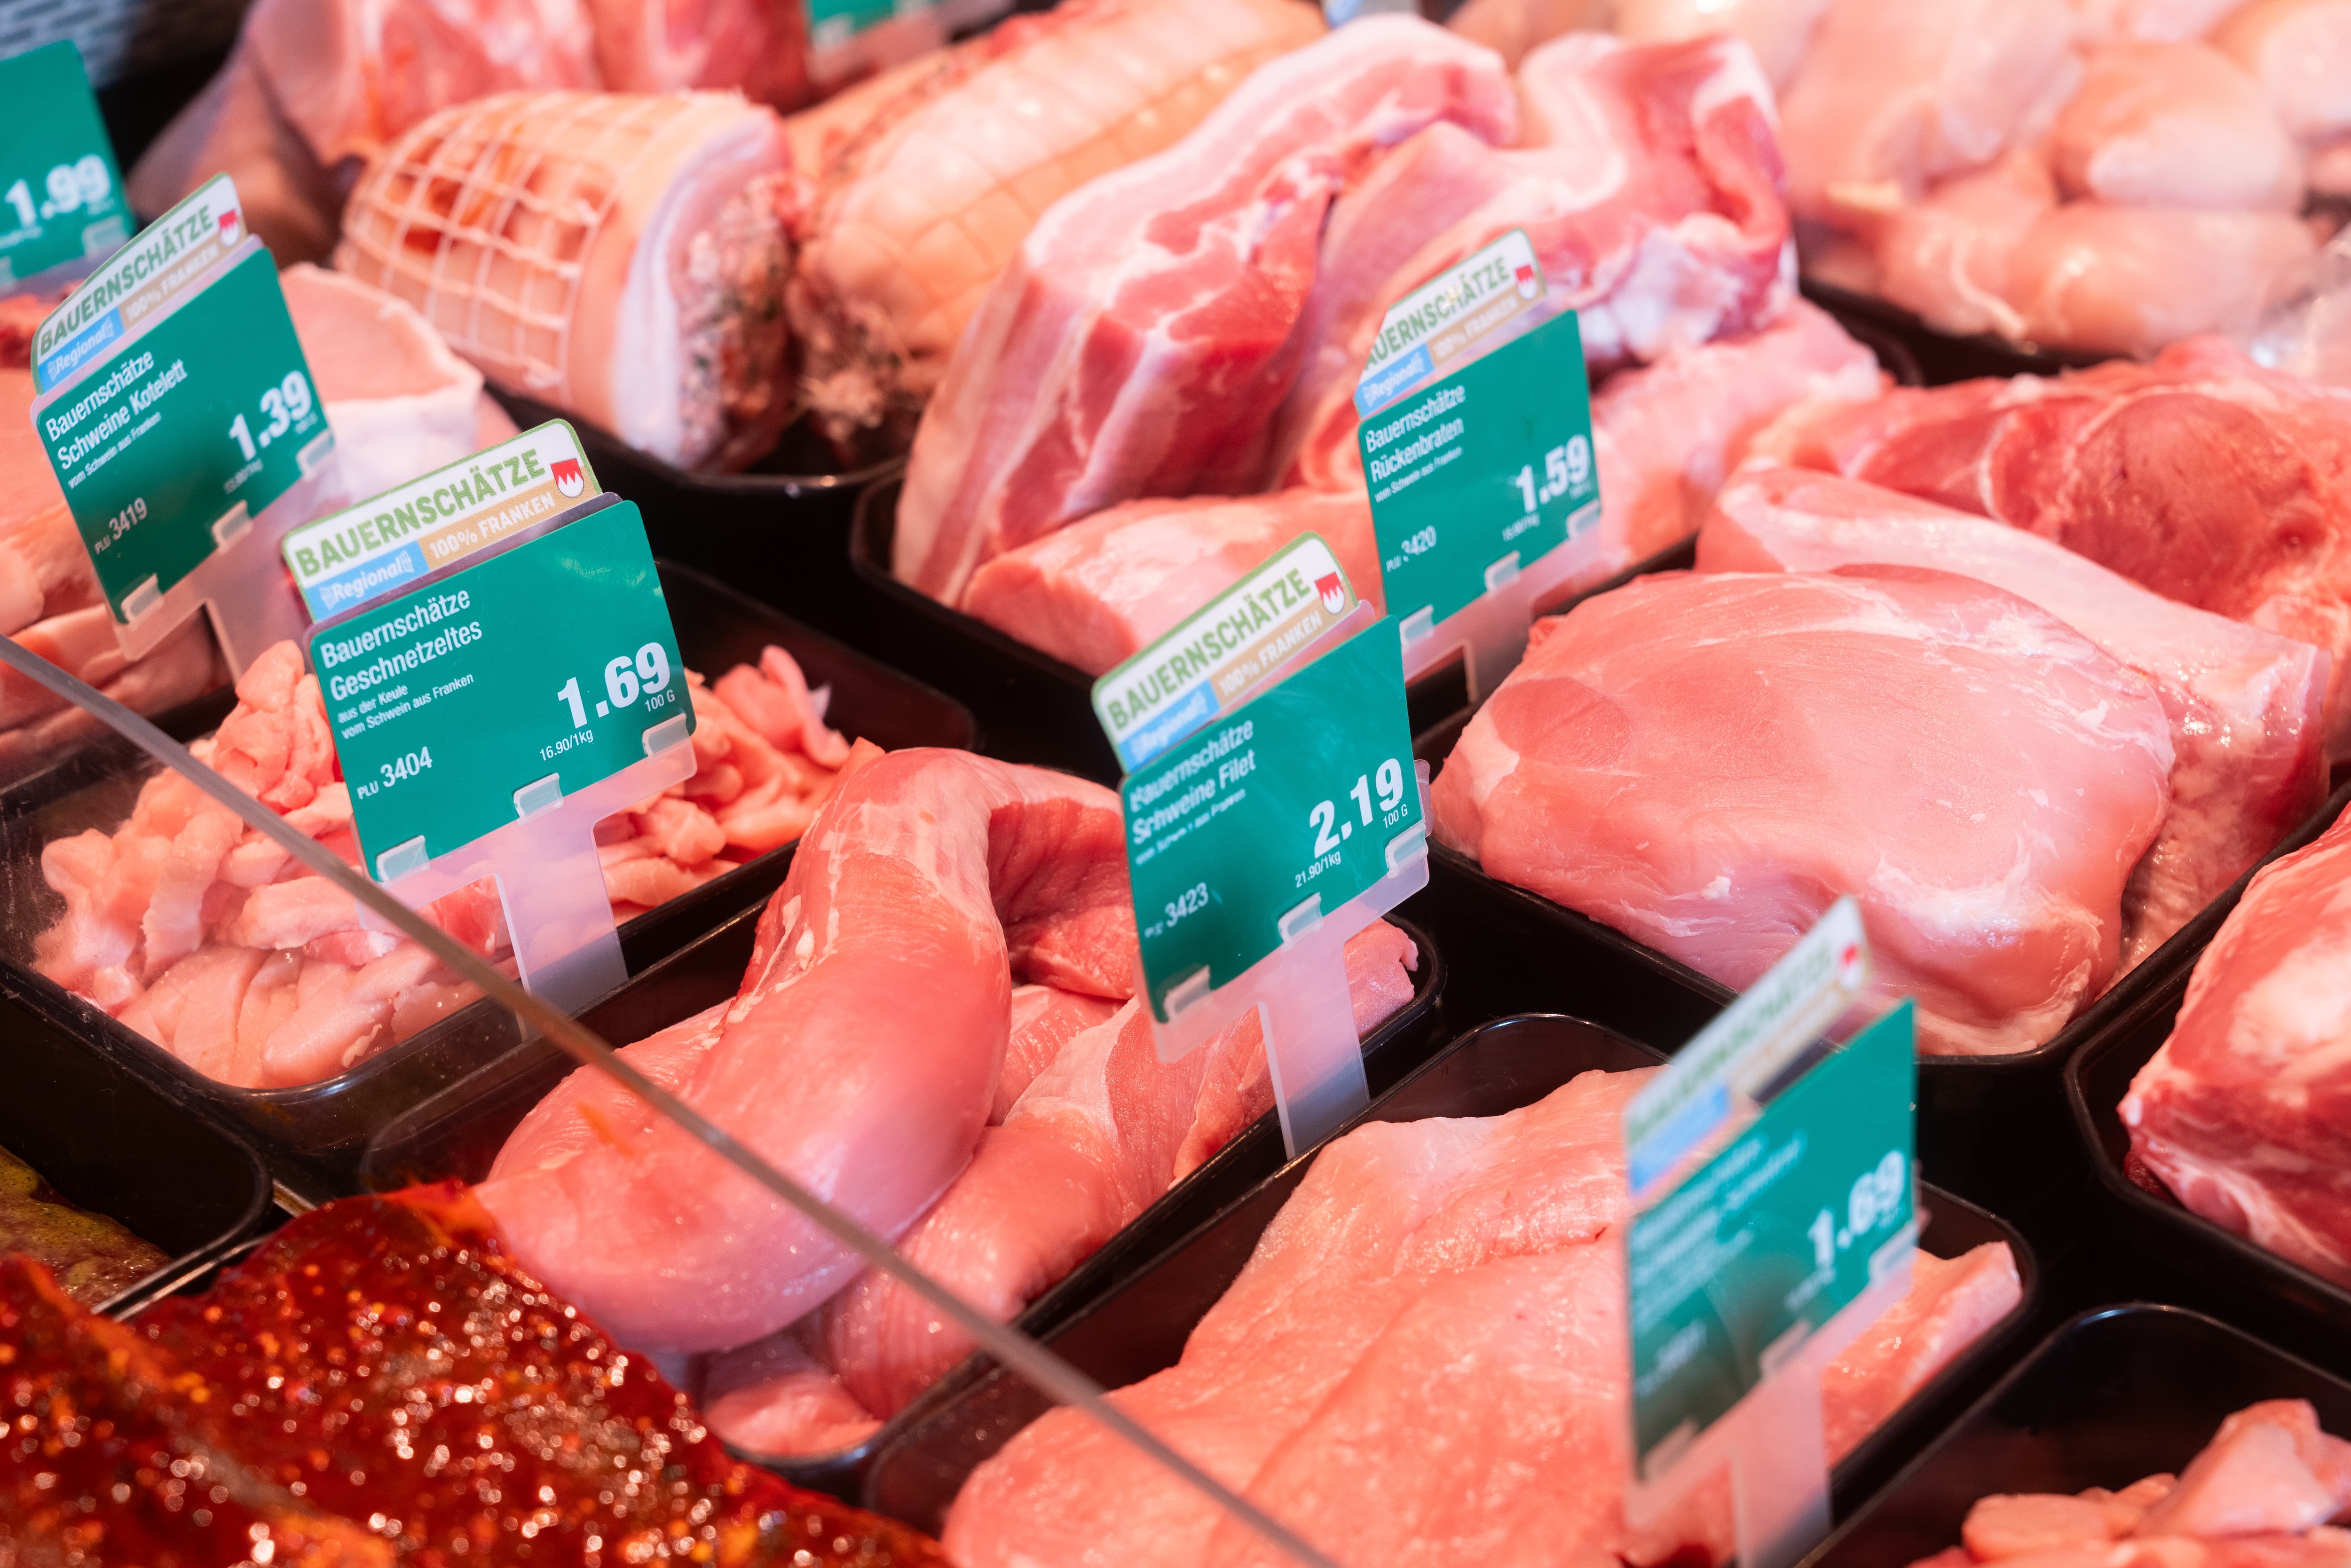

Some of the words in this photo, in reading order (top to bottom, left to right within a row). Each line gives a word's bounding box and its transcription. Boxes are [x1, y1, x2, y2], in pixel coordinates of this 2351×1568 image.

[5, 154, 111, 228] 1.99
[39, 204, 214, 356] BAUERNSCHÄTZE
[1364, 257, 1509, 371] AUERNSCHÄTZE
[55, 325, 106, 373] Regional
[45, 351, 154, 442] Bauernschätze
[57, 406, 130, 470] Schweine
[128, 359, 188, 416] Kotelett
[229, 370, 312, 461] 1.39
[1365, 385, 1466, 453] Bauernschätze
[68, 471, 86, 489] vom
[85, 445, 118, 476] Schwein
[1370, 418, 1464, 483] Rückenbraten
[1515, 433, 1590, 514] 1.59
[94, 534, 110, 555] PLU
[109, 497, 147, 540] 3419
[295, 448, 546, 577] BAUERNSCHÄTZE
[429, 530, 478, 559] 100%
[477, 491, 556, 538] FRANKEN
[1401, 525, 1436, 562] 3420
[331, 557, 402, 602] Regional
[320, 590, 470, 669] Bauernschätze
[330, 621, 482, 701] Geschnetzeltes
[1107, 567, 1311, 730] BAUERNSCHÄTZE
[1218, 661, 1260, 697] 100%
[1258, 610, 1323, 668] FRANKEN
[338, 707, 358, 724] aus
[358, 698, 377, 714] der
[378, 685, 408, 705] Keule
[341, 722, 366, 739] vom
[365, 701, 411, 729] Schwein
[412, 693, 432, 709] aus
[432, 673, 474, 699] Franken
[557, 642, 670, 729] 1.69
[645, 694, 664, 712] 100
[666, 689, 675, 703] G
[356, 780, 379, 799] PLU
[380, 746, 433, 787] 3404
[539, 729, 593, 761] 16.90/1kg
[1132, 778, 1216, 845] Schweine
[1219, 749, 1256, 790] Filet
[1309, 758, 1404, 859] 2.19
[1382, 809, 1399, 828] 100
[1401, 804, 1408, 817] G
[1164, 882, 1209, 928] 3423
[1295, 851, 1341, 888] 21.90/1kg
[1807, 1149, 1906, 1269] 1.69
